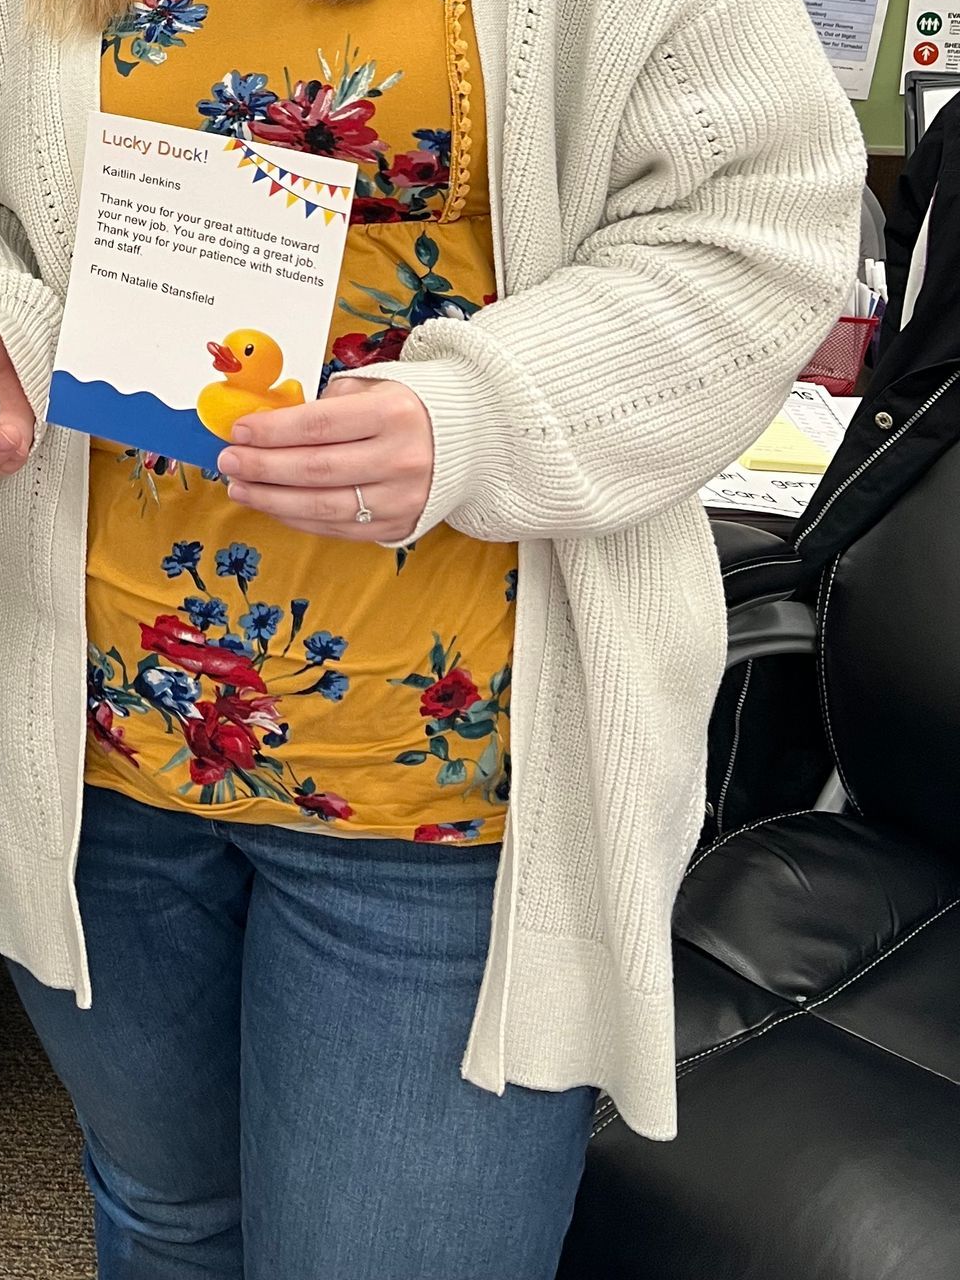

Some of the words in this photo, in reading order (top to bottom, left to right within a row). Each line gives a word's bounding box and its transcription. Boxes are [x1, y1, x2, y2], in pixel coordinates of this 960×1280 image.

[102, 130, 152, 155] Lucky
[157, 140, 208, 164] Duck!
[102, 164, 136, 180] Kaitlin
[139, 173, 181, 190] Jenkins
[97, 209, 122, 221] your
[124, 215, 147, 227] new
[148, 219, 169, 233] job.
[173, 224, 195, 239] You
[198, 233, 216, 244] are
[219, 236, 250, 254] doing
[253, 246, 260, 255] a
[263, 249, 293, 263] great
[294, 255, 316, 269] job.
[100, 192, 133, 209] Thank
[136, 202, 156, 214] you
[159, 206, 174, 218] for
[176, 212, 202, 225] your
[204, 218, 233, 233] great
[236, 226, 277, 243] attitude
[280, 236, 320, 253] toward
[94, 237, 114, 249] and
[117, 243, 143, 256] staff.
[96, 221, 130, 238] Thank
[132, 232, 152, 244] you
[155, 236, 170, 248] for
[172, 242, 198, 254] your
[199, 249, 246, 267] patience
[250, 260, 272, 274] with
[276, 267, 324, 287] students
[90, 263, 118, 280] From
[120, 272, 158, 291] Natalie
[161, 282, 215, 306] Stansfield
[722, 489, 778, 504] card
